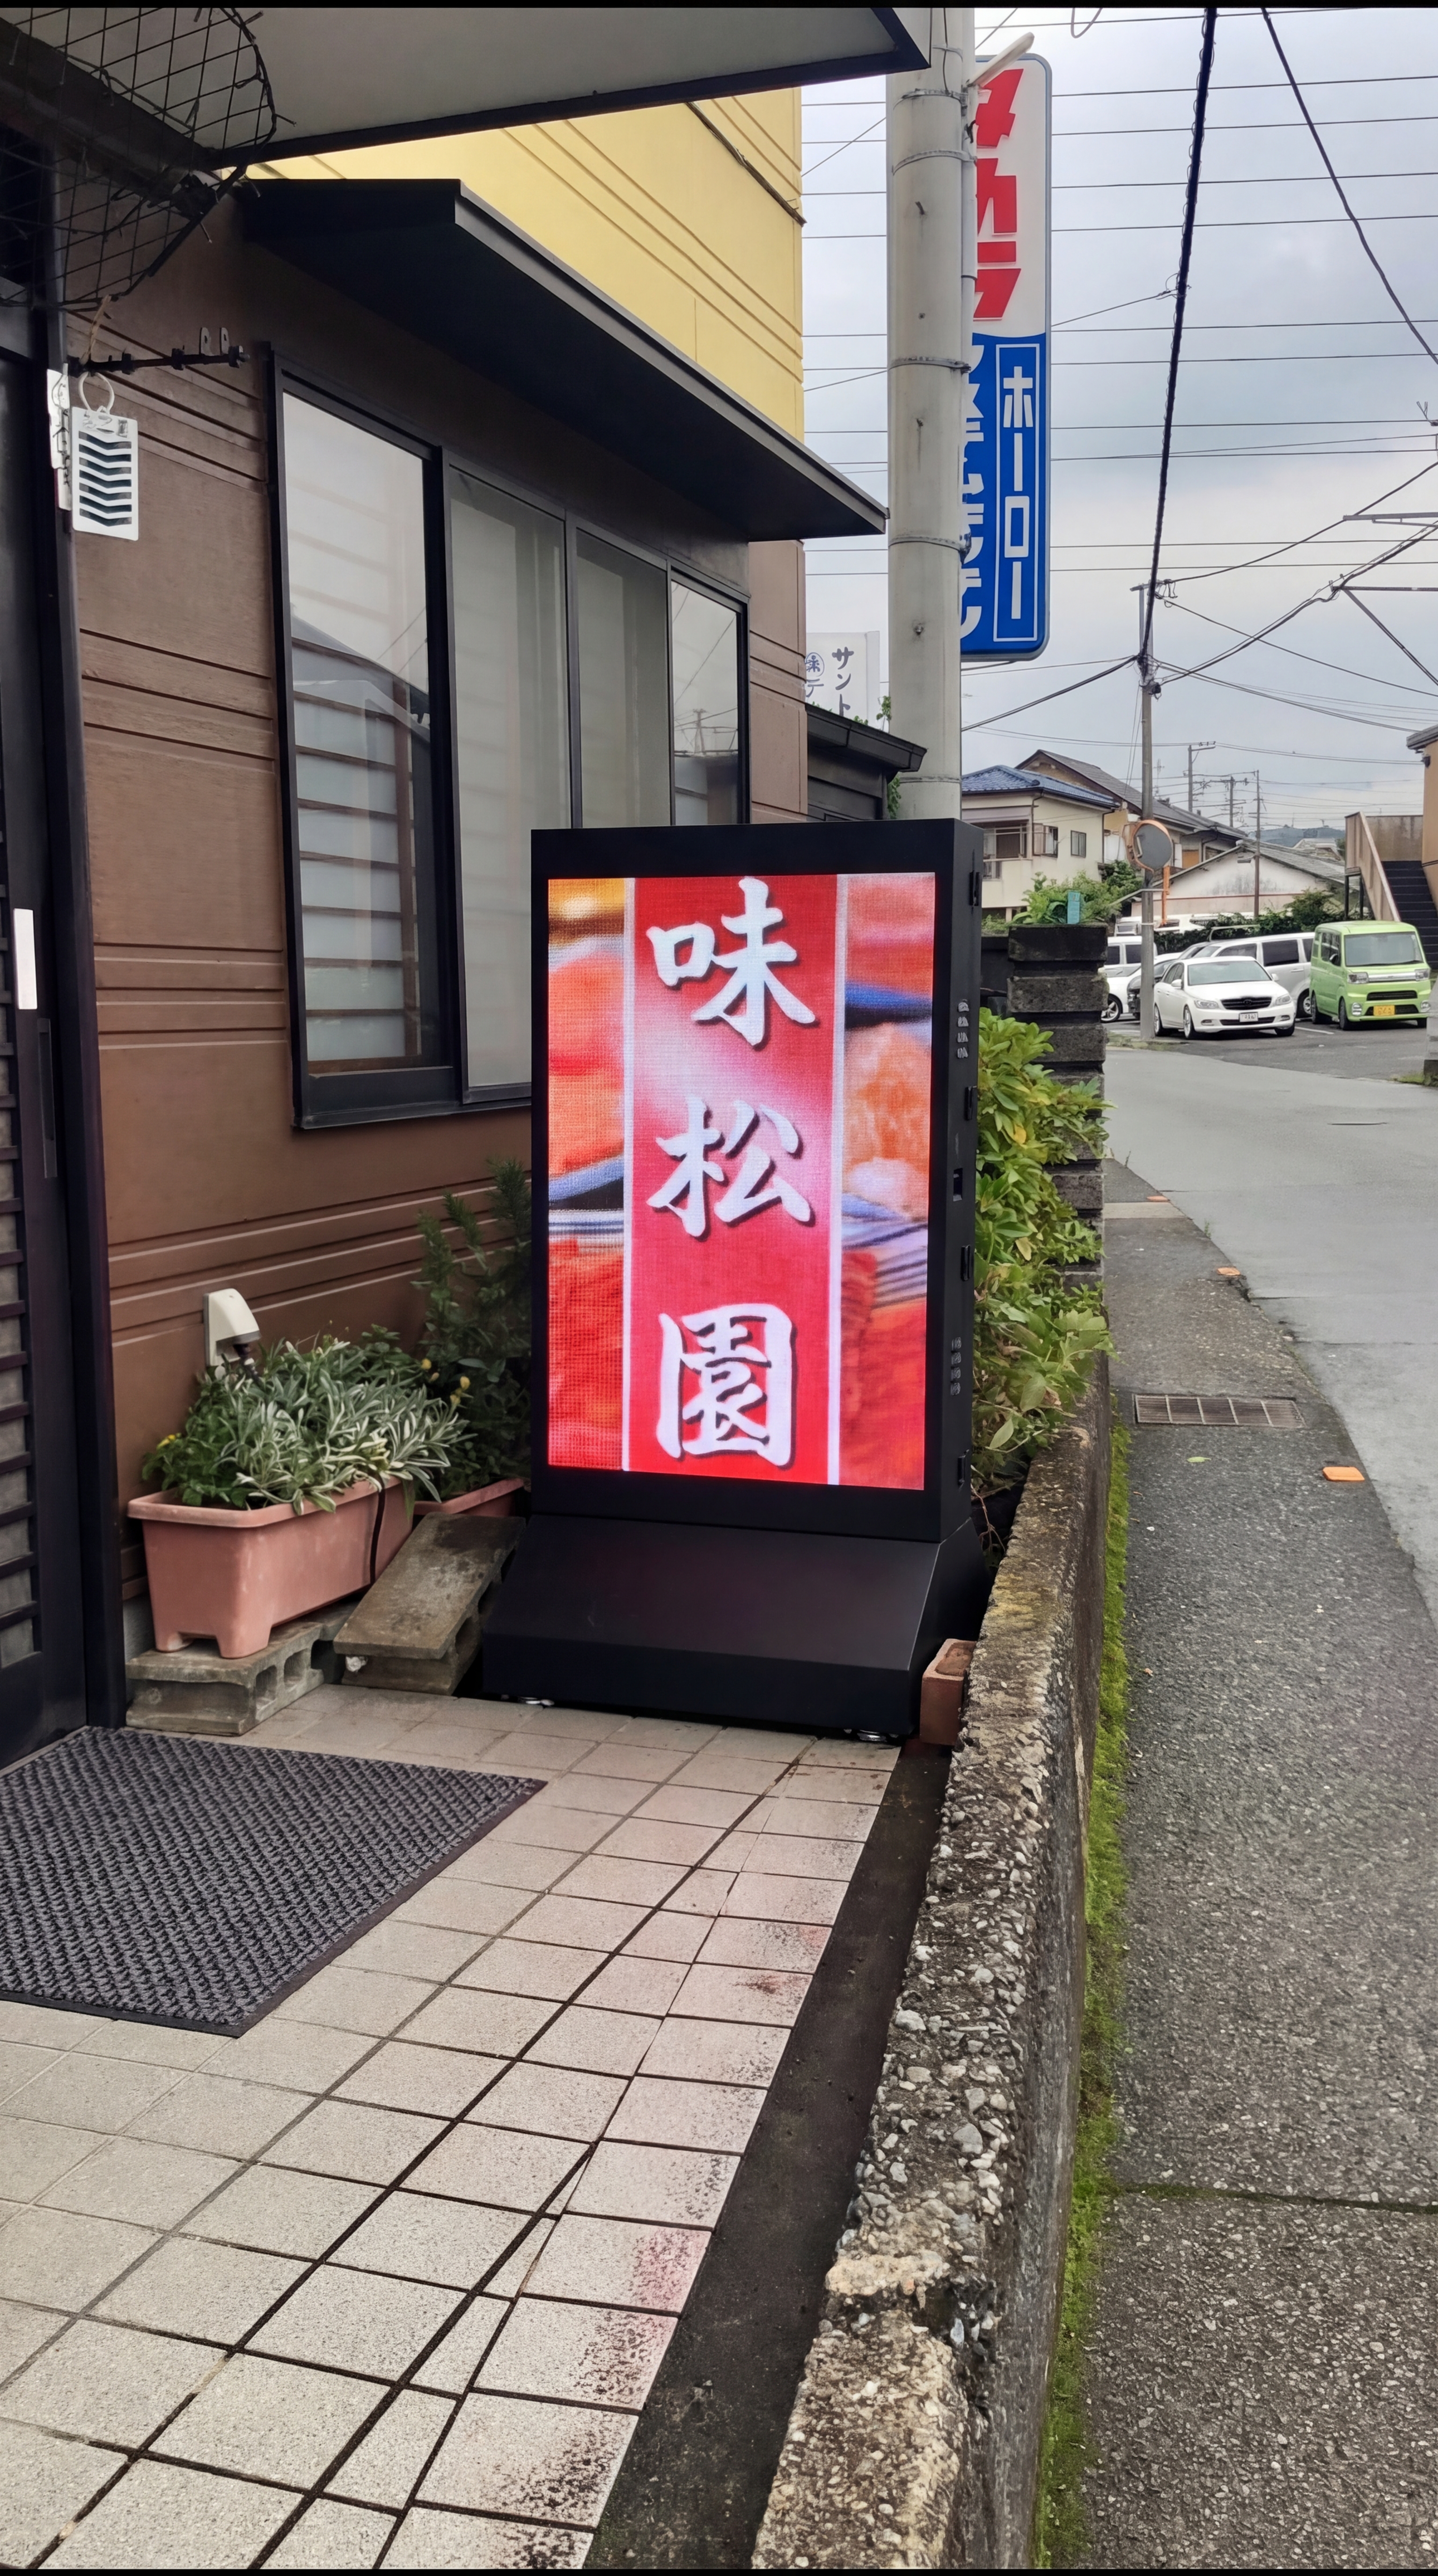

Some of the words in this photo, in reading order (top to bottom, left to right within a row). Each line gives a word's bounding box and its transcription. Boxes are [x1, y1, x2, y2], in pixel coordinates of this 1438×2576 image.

[1003, 366, 1034, 620] ホーロー
[646, 877, 815, 1468] 味松園
